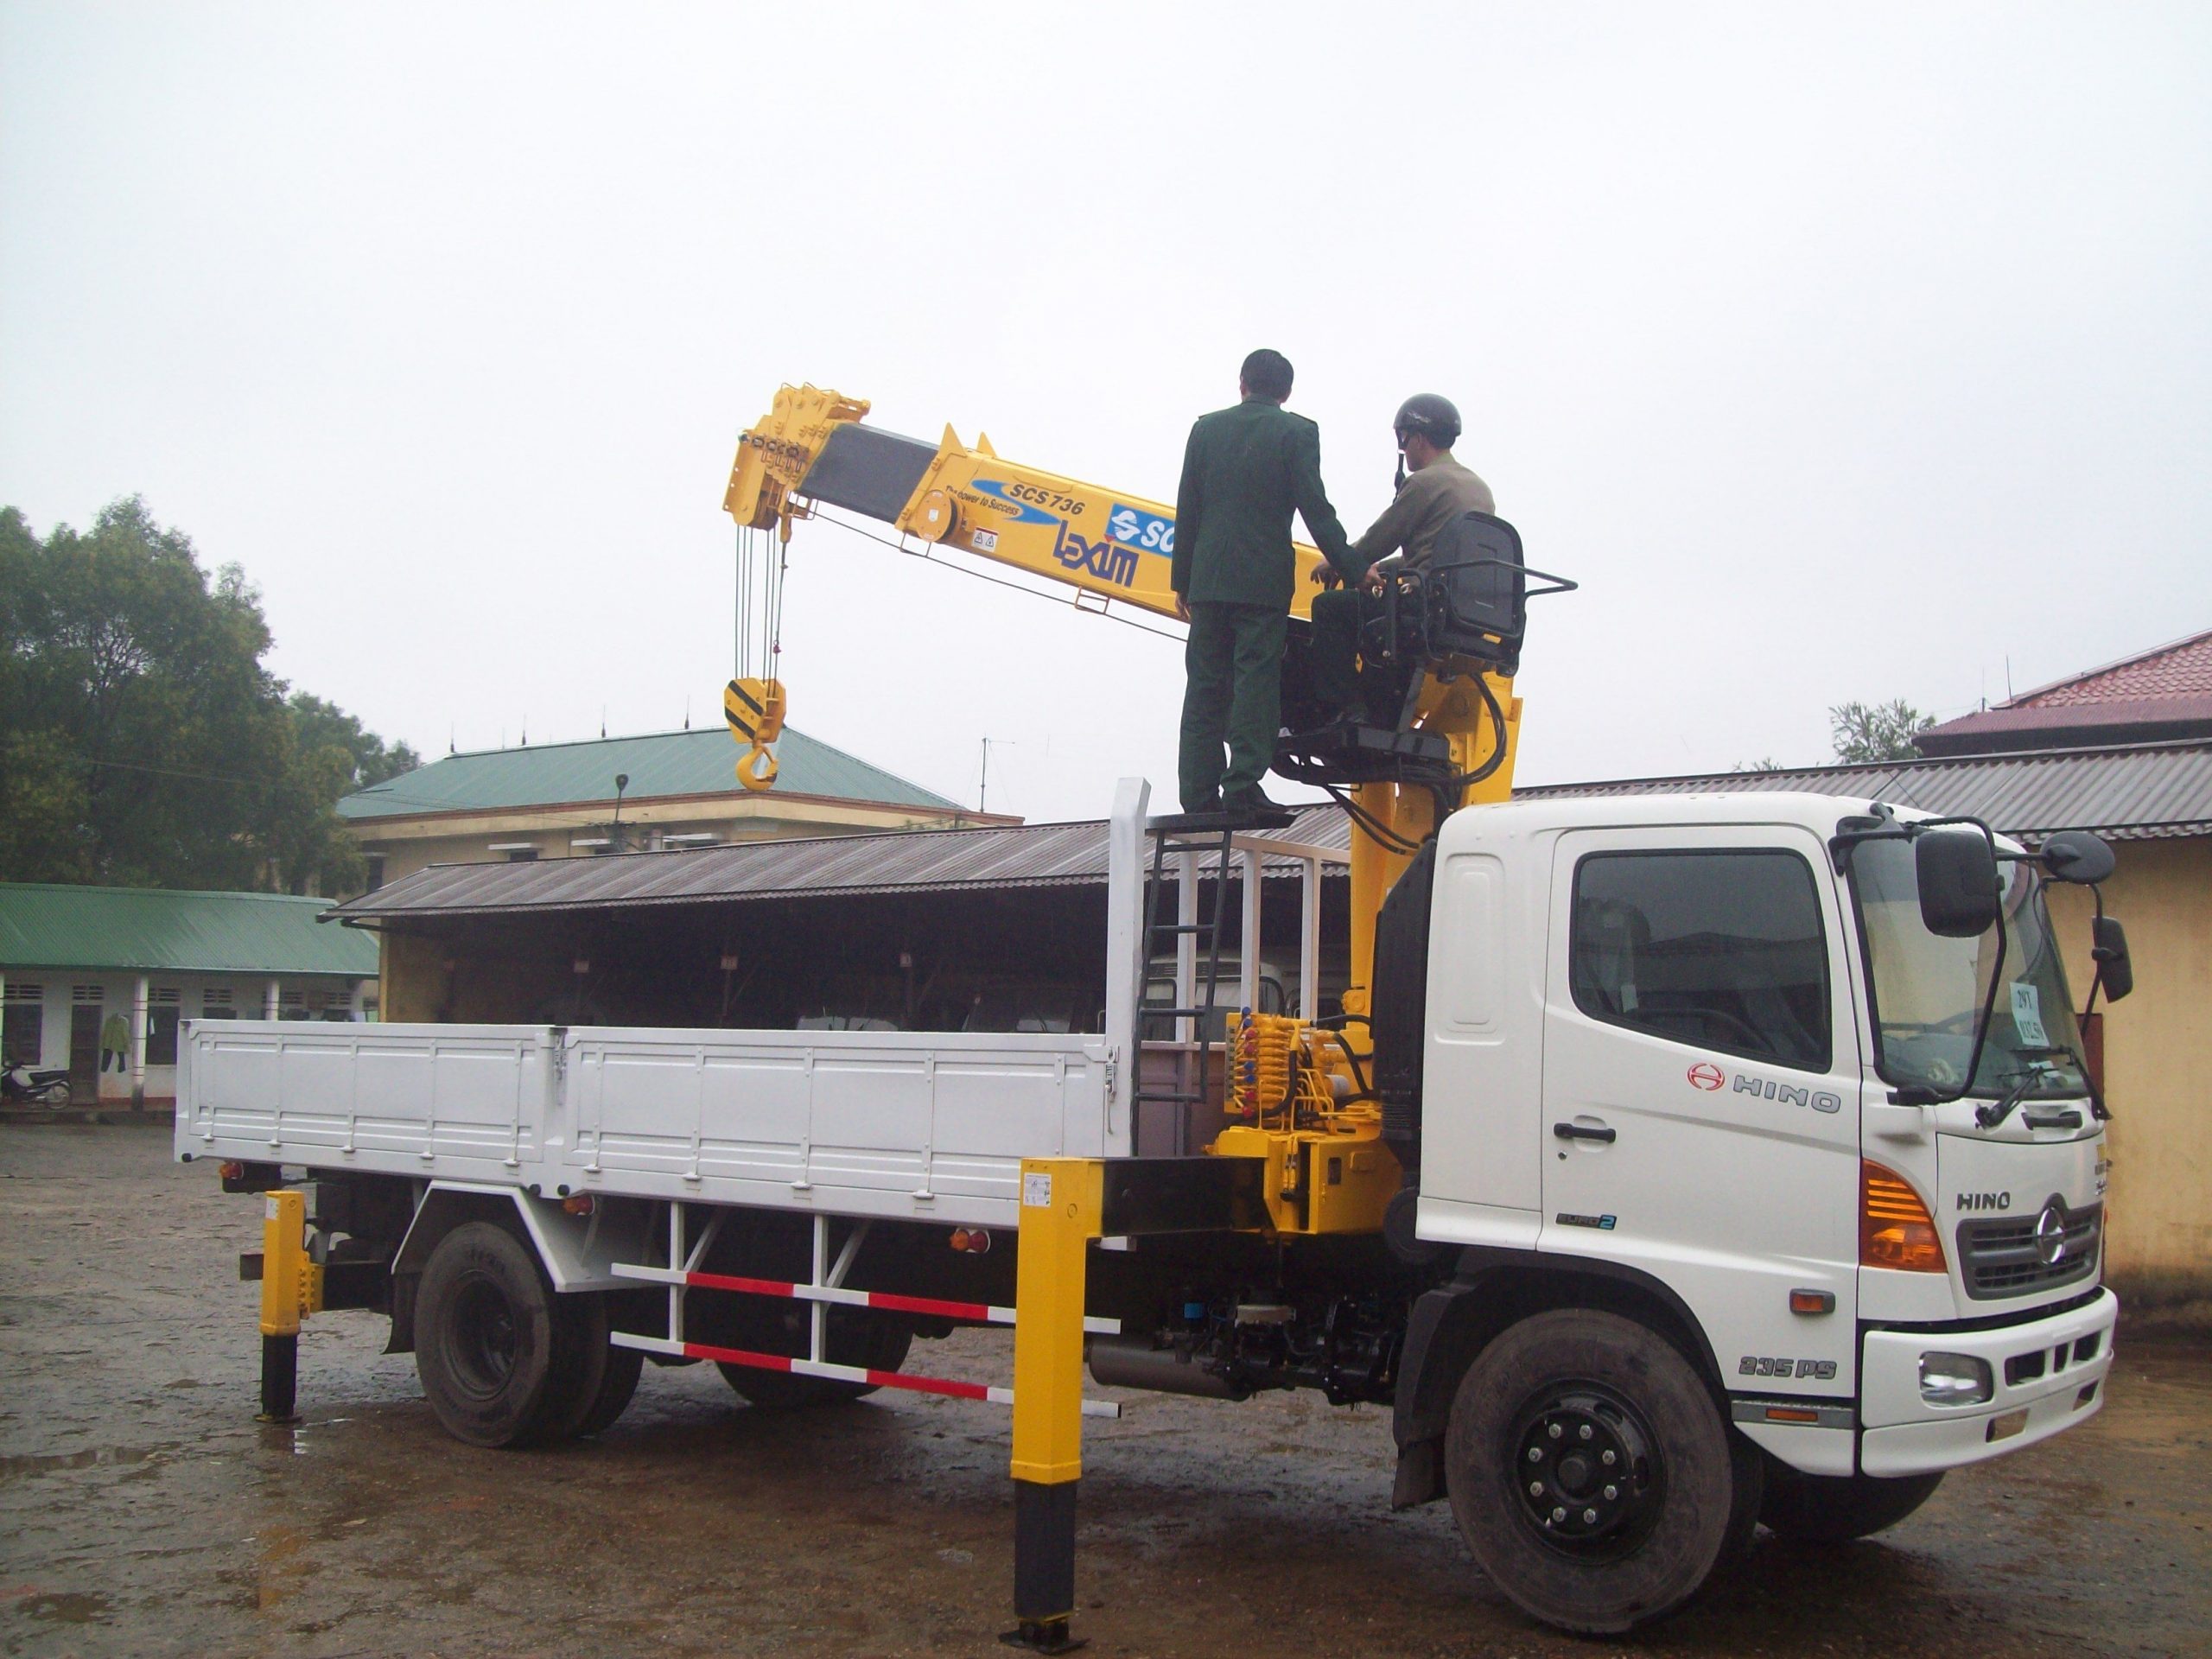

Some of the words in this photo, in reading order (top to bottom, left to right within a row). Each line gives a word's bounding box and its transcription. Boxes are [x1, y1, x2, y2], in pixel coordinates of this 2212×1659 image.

[988, 499, 1020, 516] Success
[1733, 1074, 1841, 1115] HINO
[1956, 1192, 2011, 1211] HINO
